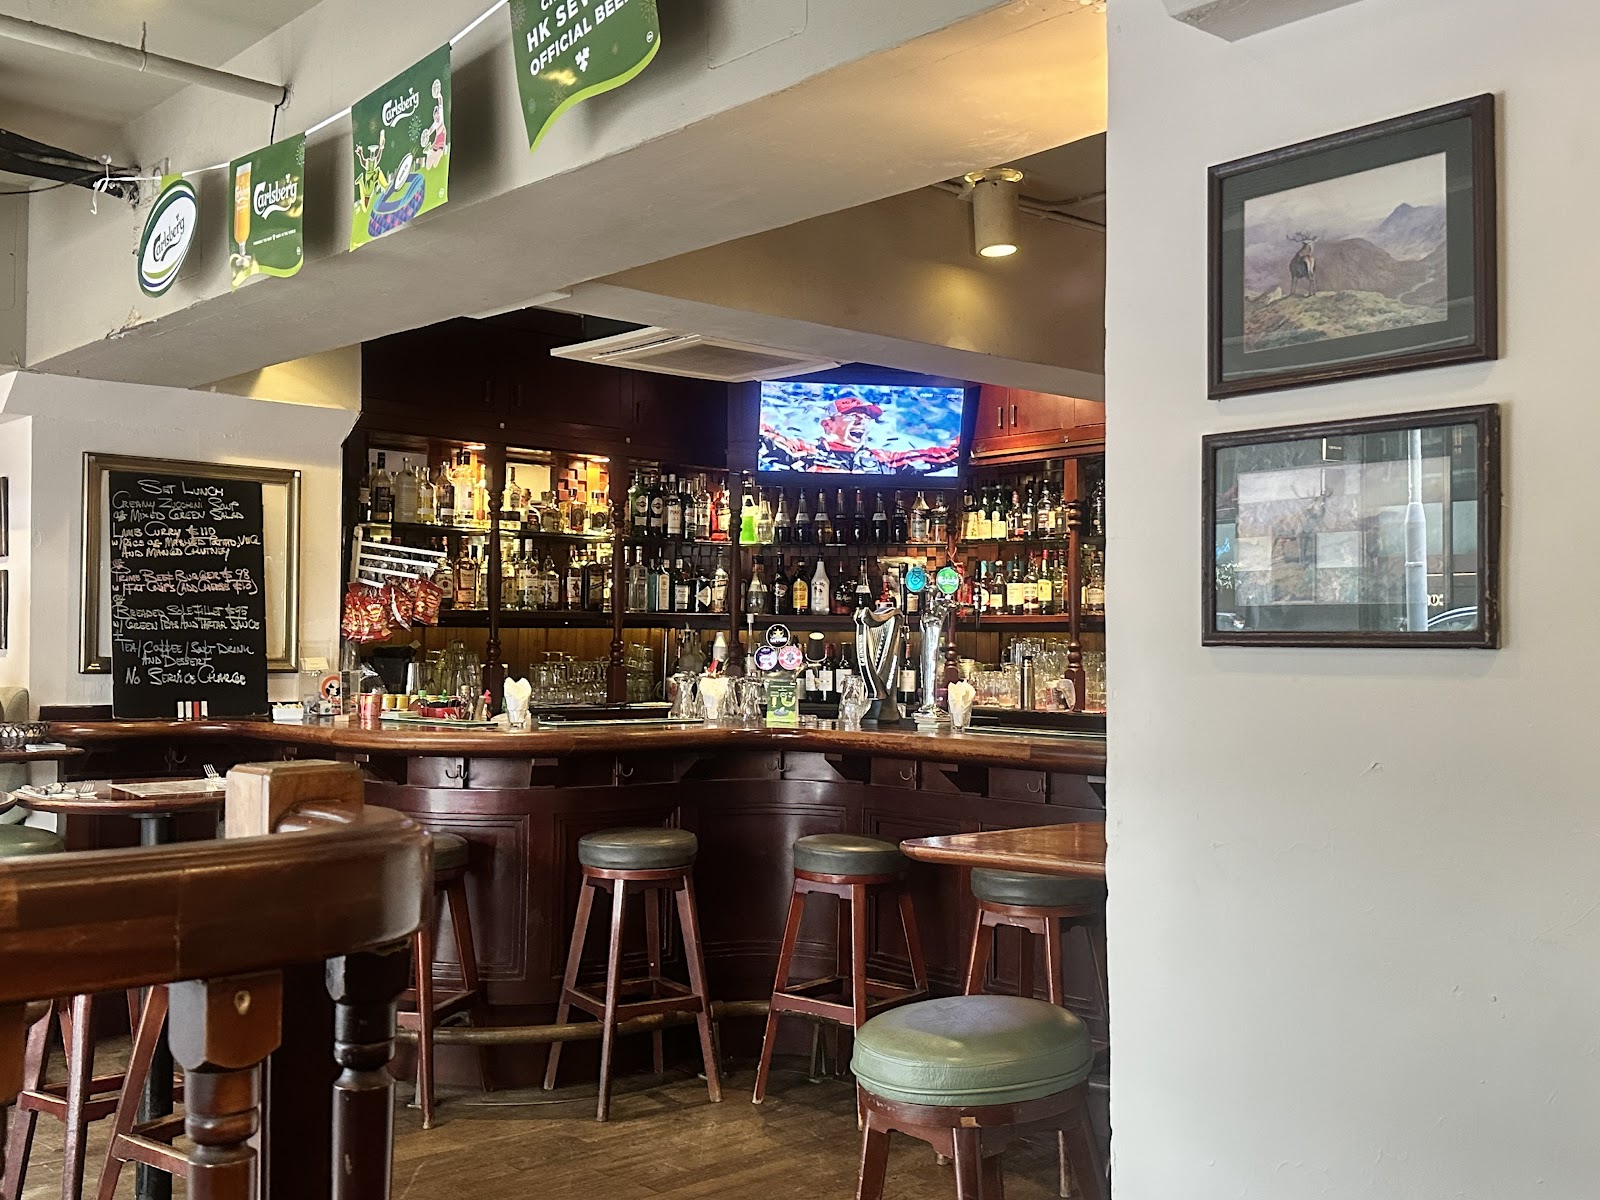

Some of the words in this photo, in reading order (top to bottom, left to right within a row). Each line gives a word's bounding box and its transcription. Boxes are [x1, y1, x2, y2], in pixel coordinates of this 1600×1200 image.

[526, 17, 551, 52] HK
[530, 17, 592, 76] OFFICIAL
[594, 0, 629, 25] BEE
[382, 91, 419, 127] Carlsberg
[253, 180, 297, 219] Carlsberg
[153, 216, 185, 262] Carlsberg
